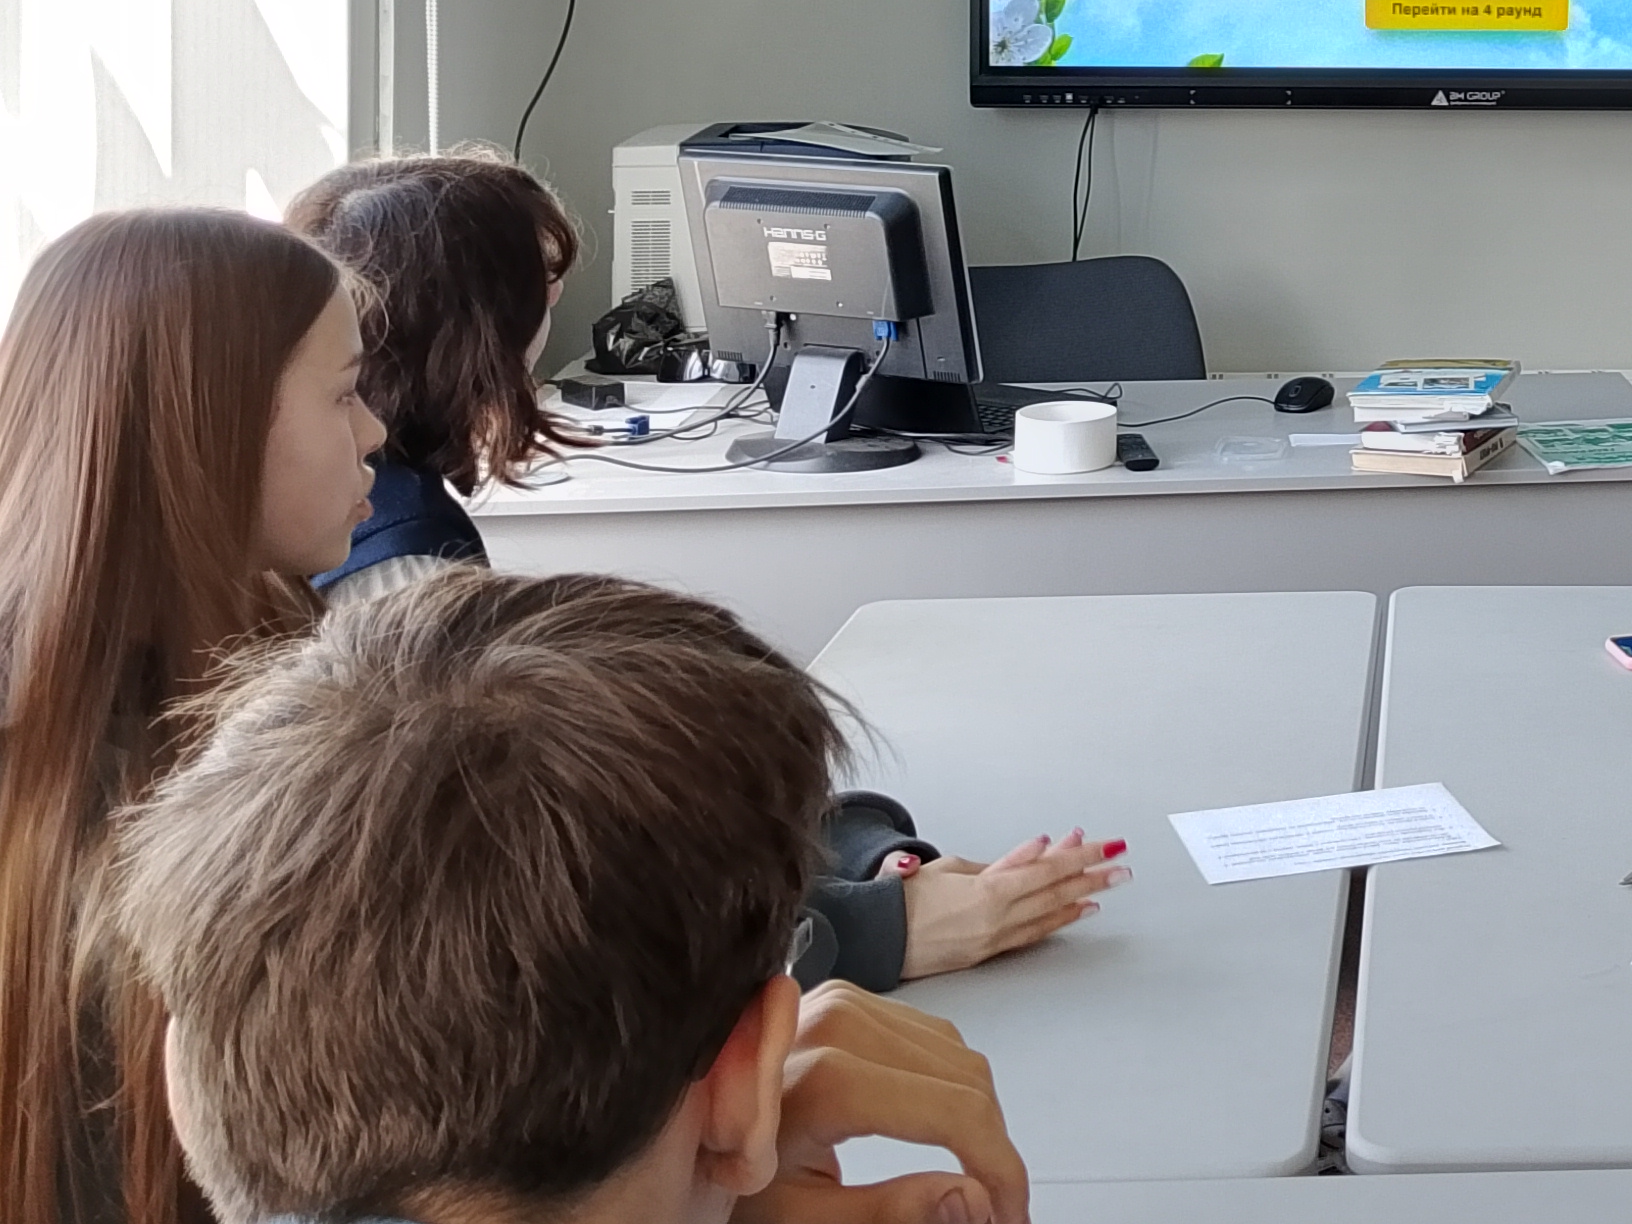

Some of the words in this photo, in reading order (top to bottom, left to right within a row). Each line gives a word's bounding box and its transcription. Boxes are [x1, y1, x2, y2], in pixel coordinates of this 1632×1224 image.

[1391, 2, 1457, 18] Перейти
[1461, 6, 1479, 16] на
[1482, 4, 1492, 16] 4
[1496, 6, 1542, 19] раунд
[1466, 91, 1501, 101] GROUP
